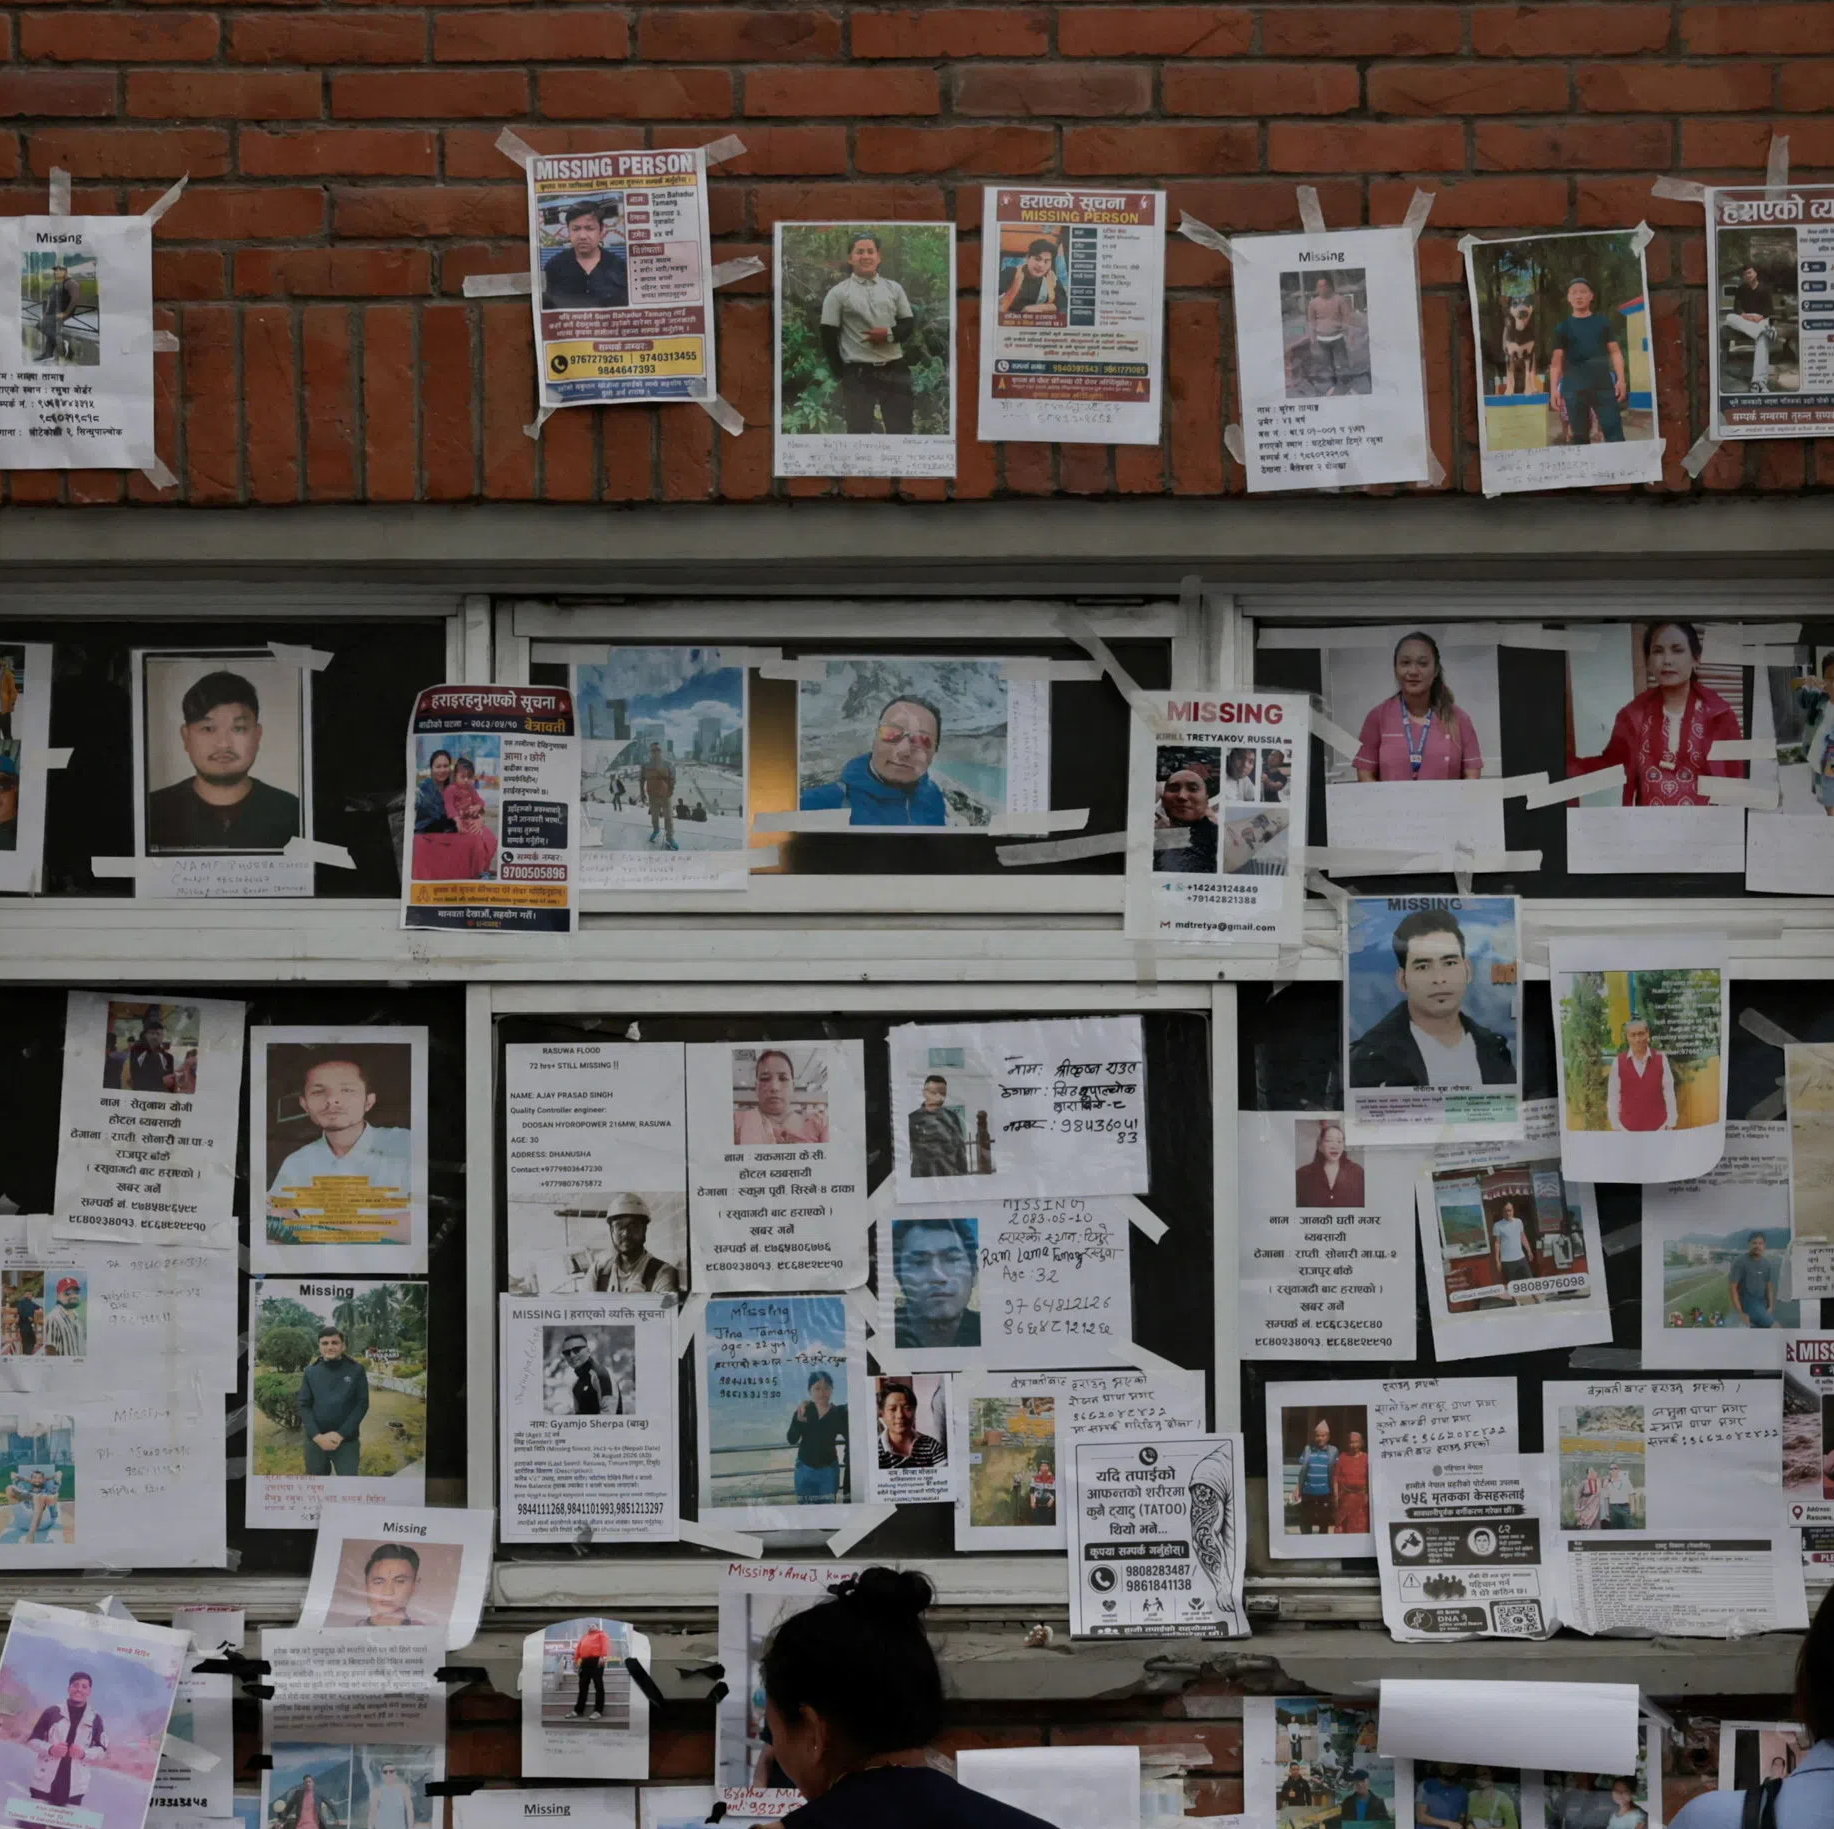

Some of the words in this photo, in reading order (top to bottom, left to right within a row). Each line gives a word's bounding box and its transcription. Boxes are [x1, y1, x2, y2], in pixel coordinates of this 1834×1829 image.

[537, 157, 613, 180] MISSING
[619, 153, 695, 177] PERSON
[1021, 210, 1080, 223] MISSING
[1084, 212, 1139, 223] PERSON
[36, 232, 82, 245] Missing
[1168, 701, 1283, 725] MISSING
[1387, 898, 1462, 911] MISSING
[1175, 921, 1276, 932] mdtretya@gmail.com
[542, 1047, 575, 1055] RASUWA
[510, 1092, 534, 1100] NAME:
[557, 1091, 588, 1099] PRASAD
[589, 1091, 613, 1099] SINGH
[299, 1284, 354, 1299] Missing
[383, 1522, 428, 1537] Missing
[1125, 1564, 1197, 1577] 9808283487/
[1126, 1580, 1192, 1592] 9861841138
[524, 1803, 571, 1815] Missing
